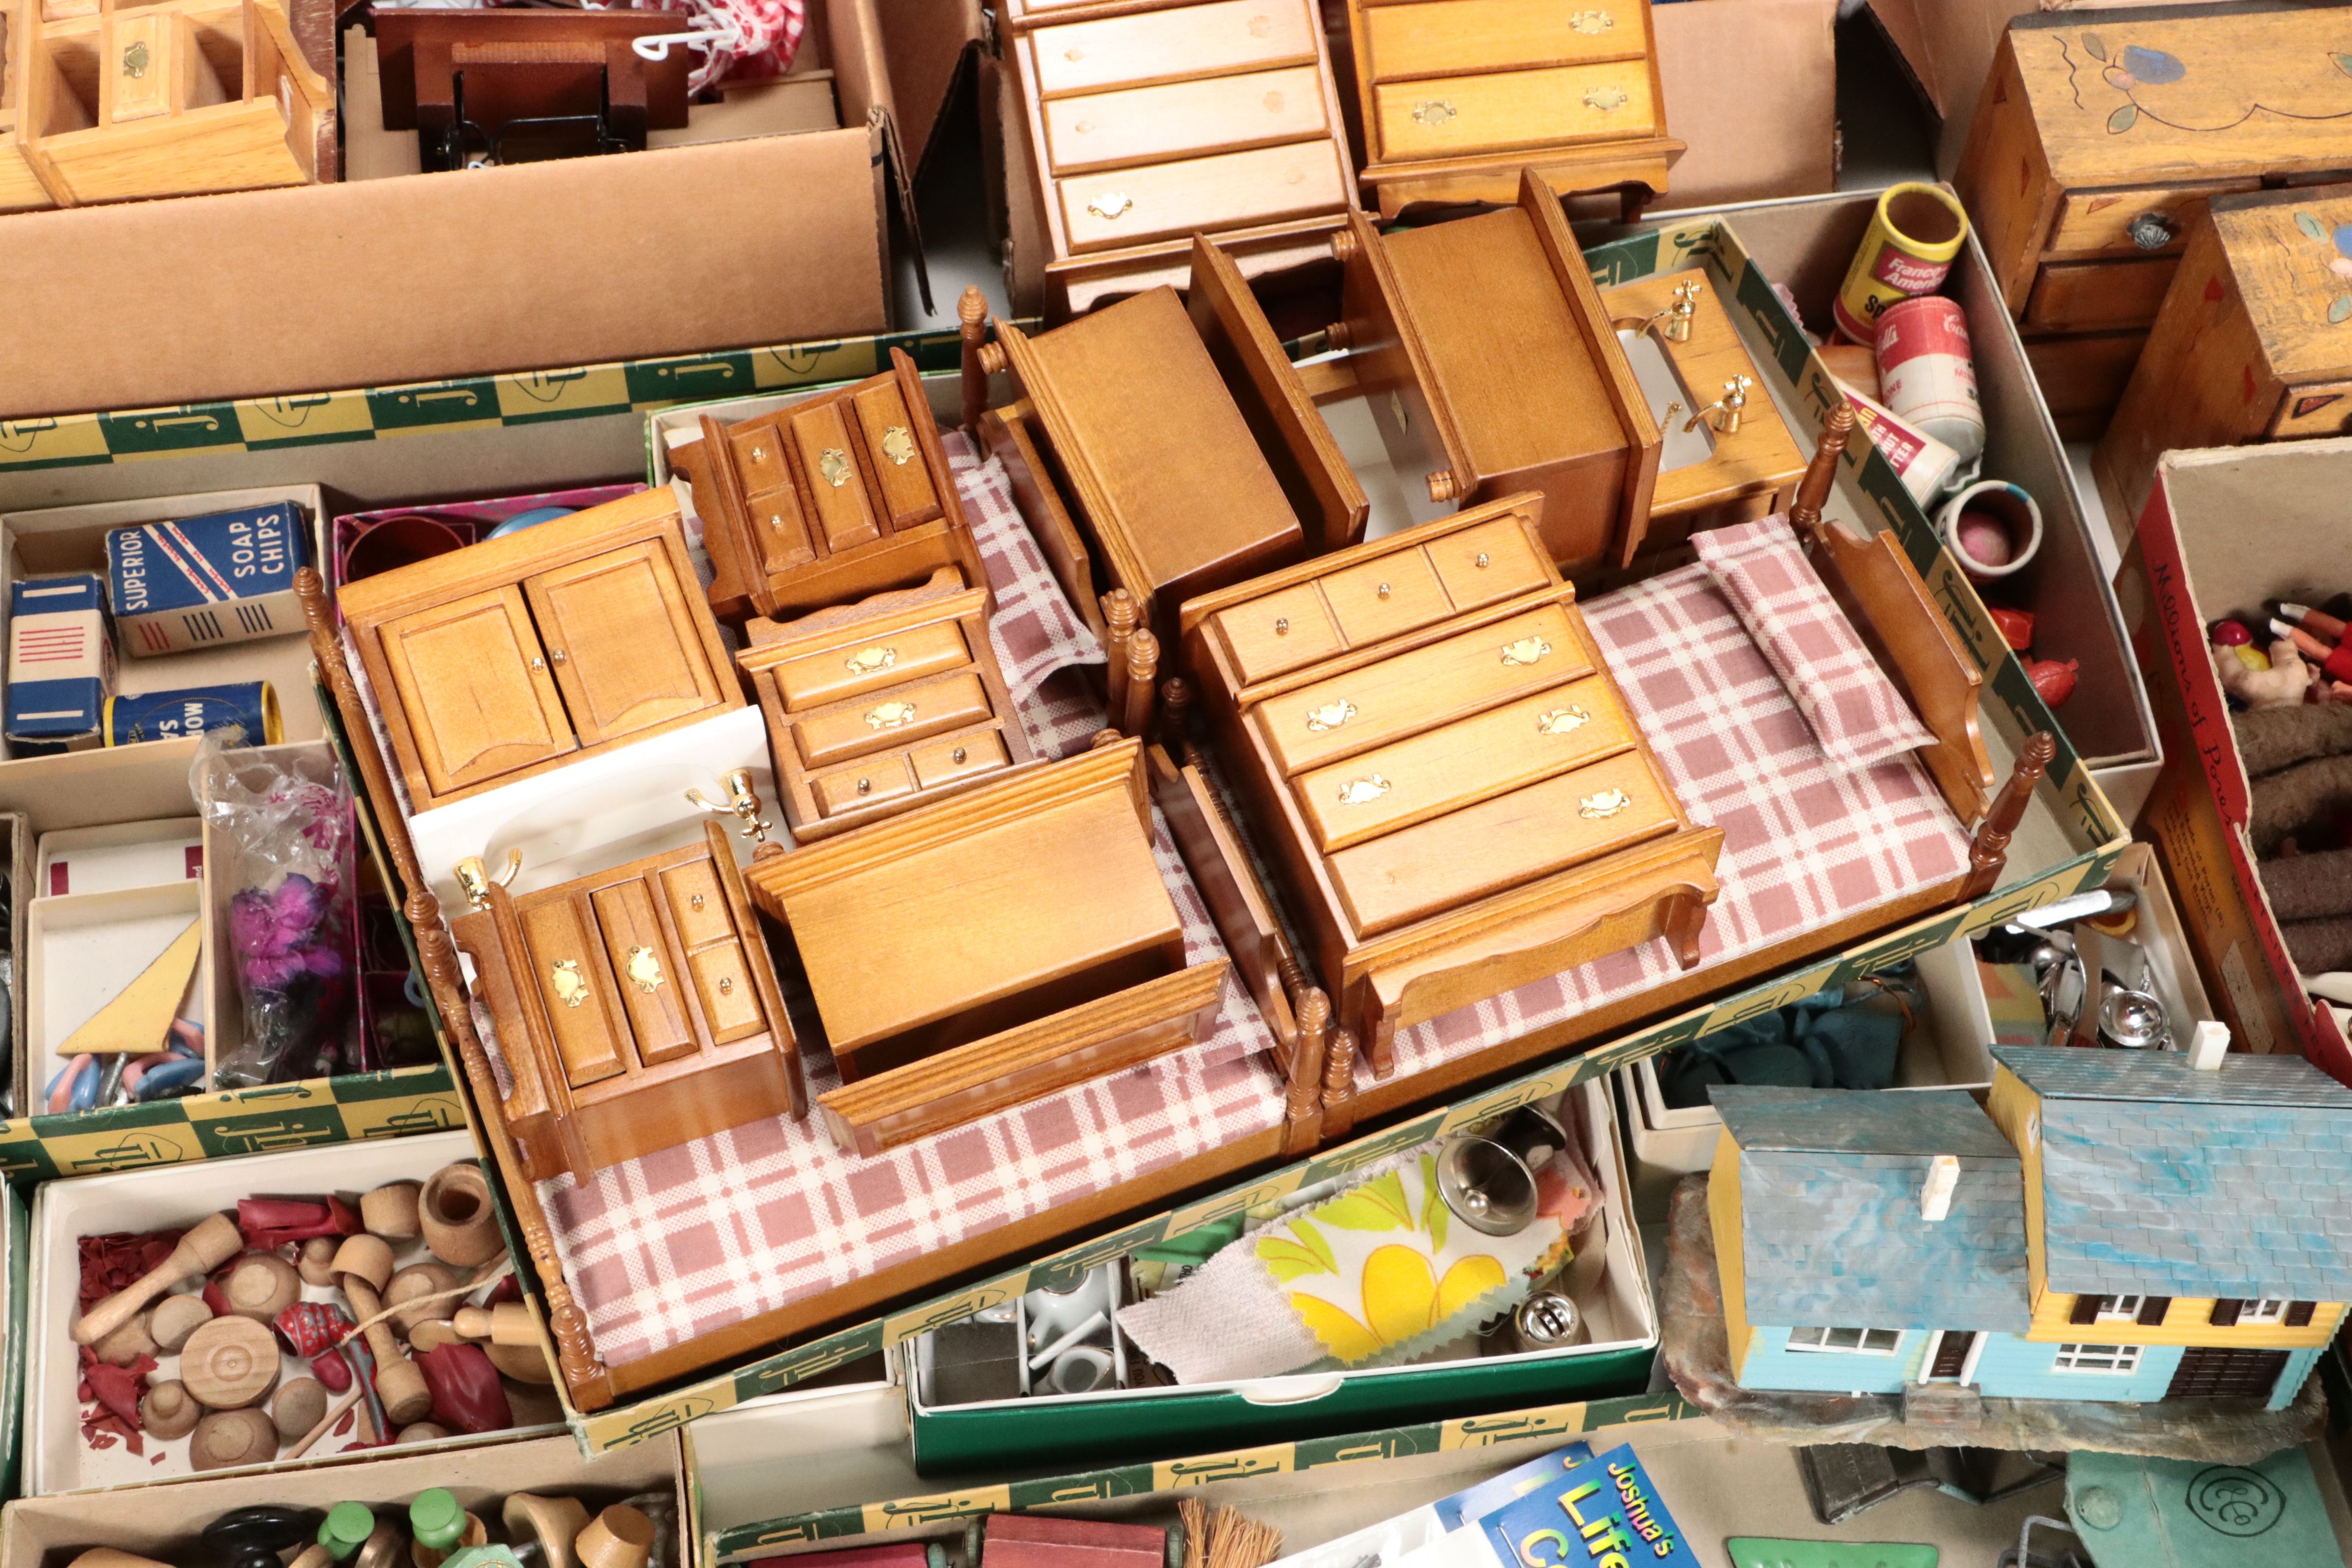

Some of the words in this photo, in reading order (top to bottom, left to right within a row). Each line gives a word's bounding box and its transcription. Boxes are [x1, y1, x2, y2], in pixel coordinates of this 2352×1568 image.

[1888, 257, 1948, 278] Franco-
[119, 531, 149, 611] SUPERIOR
[228, 521, 256, 578] SOAP
[256, 514, 285, 574] CHIPS
[2191, 701, 2207, 728] of
[2203, 738, 2232, 827] Pores
[1608, 1462, 1675, 1557] Joshua's
